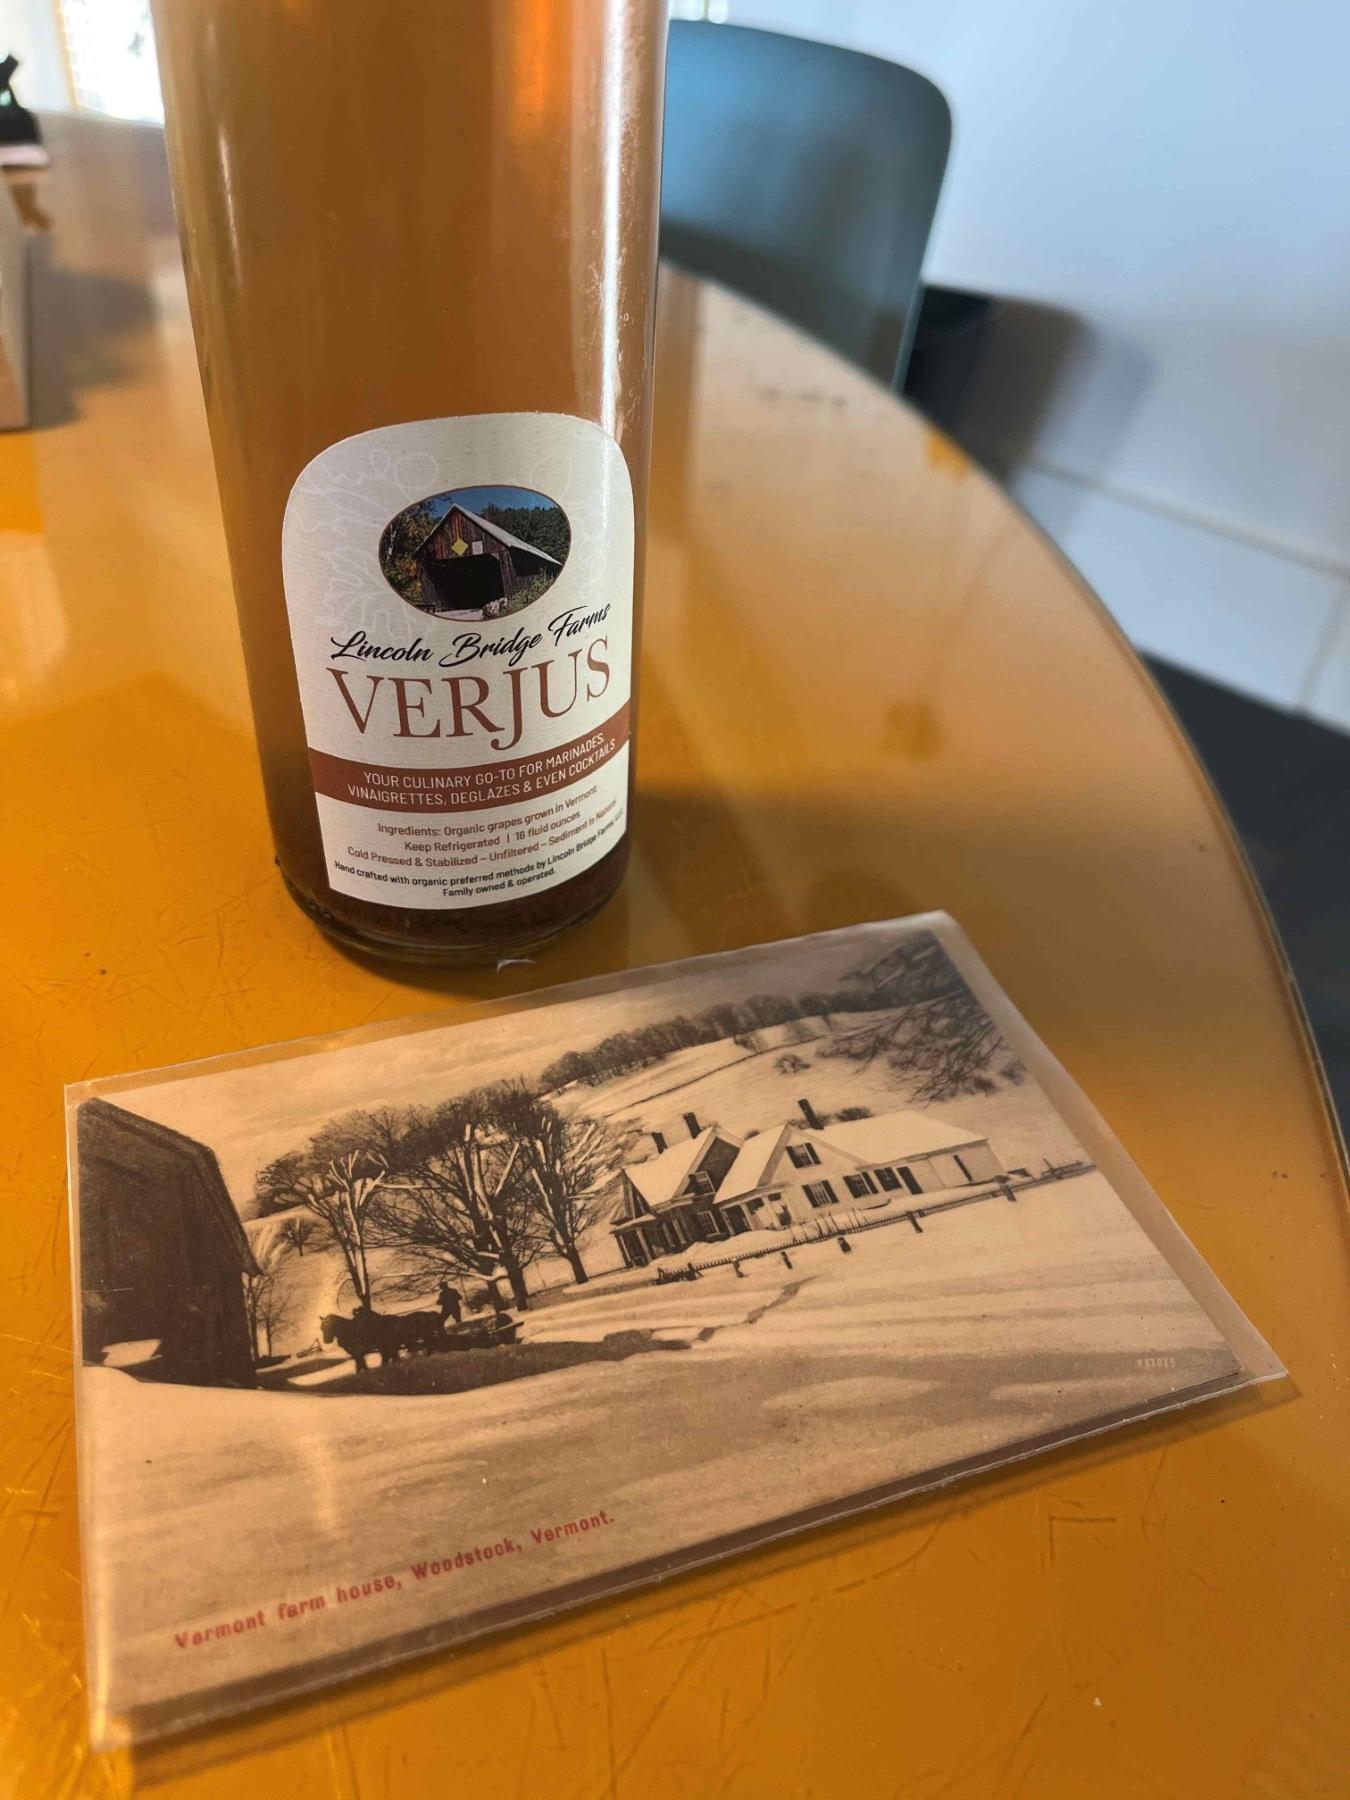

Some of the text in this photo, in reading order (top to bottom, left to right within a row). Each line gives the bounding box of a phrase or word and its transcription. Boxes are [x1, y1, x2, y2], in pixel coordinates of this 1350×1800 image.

[331, 603, 612, 668] Lincoln Bridge Farms
[326, 636, 611, 751] VERJUS
[348, 739, 616, 806] VINAIGRETTES, DEGLAZES & EVEN COCKTAILS
[363, 771, 400, 787] YOUR
[403, 775, 471, 789] CULINARY
[475, 768, 516, 786] GO-TO
[519, 760, 543, 778] FOR
[377, 823, 441, 836] Ingredients:
[444, 823, 486, 837] Organic
[487, 818, 523, 834] grapes
[525, 808, 554, 825] grown
[555, 803, 564, 813] in
[404, 841, 432, 853] Keep
[434, 836, 501, 853] Refrigerated
[515, 831, 526, 841] 16
[528, 823, 549, 837] fluid
[550, 811, 581, 830] ounces
[347, 846, 369, 860] Cold
[371, 851, 412, 867] Pressed
[414, 857, 423, 867] &
[425, 855, 478, 868] Stabilized
[489, 843, 540, 862] Unfiltered
[548, 821, 588, 846] Sediment
[334, 860, 355, 875] Hand
[356, 868, 388, 882] crafted
[390, 875, 410, 886] with
[412, 877, 448, 888] organic
[450, 872, 494, 887] preferred
[496, 863, 535, 879] methods
[536, 858, 547, 869] by
[547, 848, 575, 865] Lincoln
[443, 887, 474, 897] Family
[475, 881, 506, 894] owned
[507, 879, 515, 888] &
[174, 1509, 615, 1650] Vermont farm house, Woodstock, Vermont.
